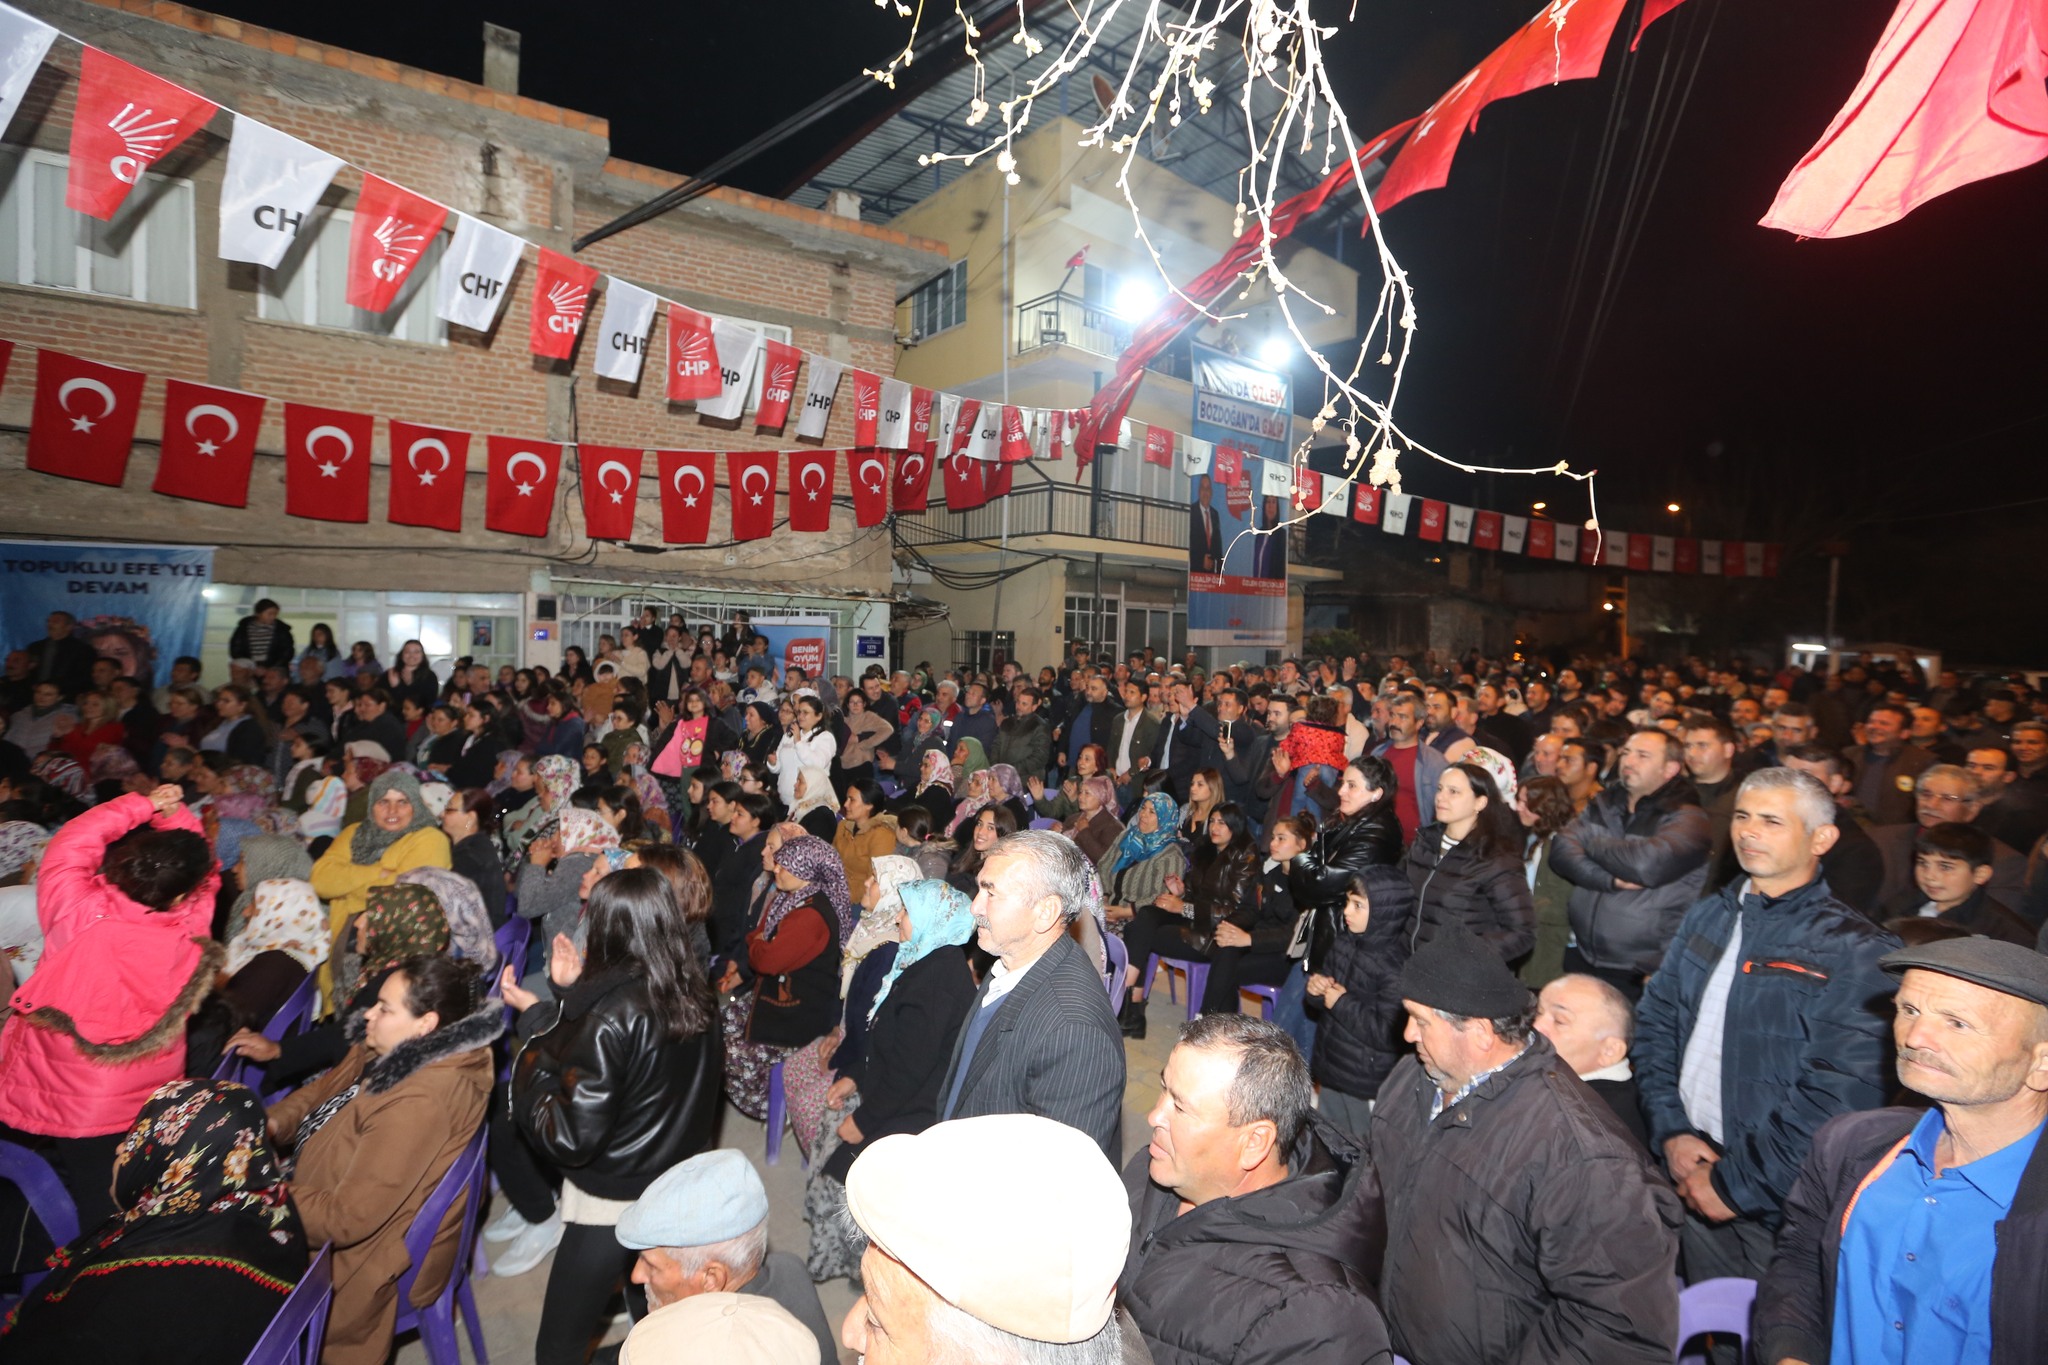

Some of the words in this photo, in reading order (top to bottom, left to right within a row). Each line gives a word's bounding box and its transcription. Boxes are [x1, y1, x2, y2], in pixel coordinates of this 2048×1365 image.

[677, 360, 710, 376] CHP
[720, 367, 741, 387] HP
[766, 387, 790, 403] CHP
[806, 392, 831, 411] CHP
[858, 408, 877, 421] CHP
[885, 409, 901, 424] CHP
[1200, 401, 1260, 432] BOZDOĞAN'DA
[981, 429, 997, 440] CHP
[1007, 432, 1024, 444] CHP
[3, 559, 117, 575] TOPUKLU
[123, 562, 207, 577] EFE'YLE
[67, 580, 149, 594] DEVAM
[792, 644, 818, 653] BENİM
